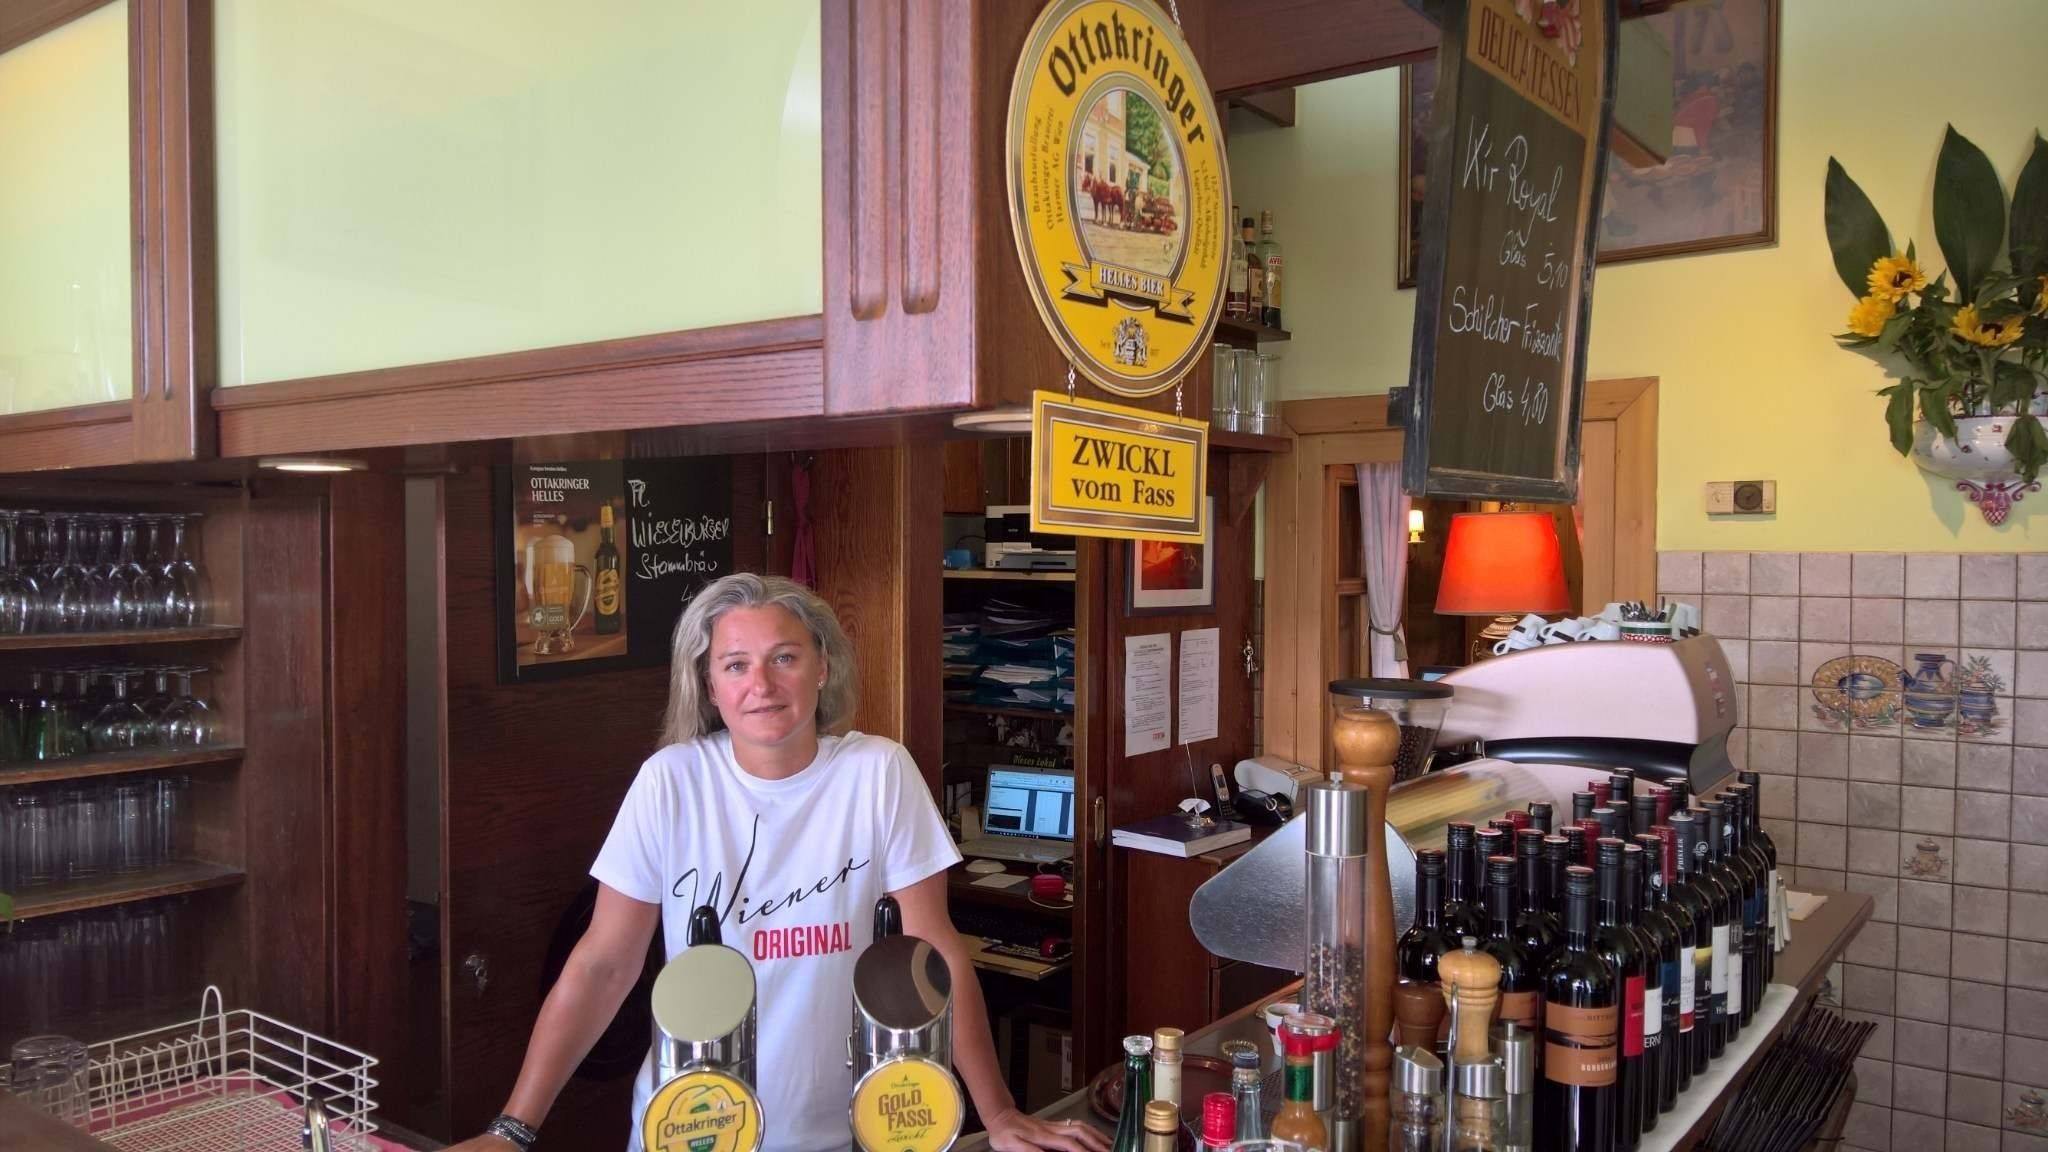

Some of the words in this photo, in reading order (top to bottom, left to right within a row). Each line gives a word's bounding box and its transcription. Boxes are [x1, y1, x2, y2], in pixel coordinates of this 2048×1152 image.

[1048, 9, 1205, 145] Ottakringer
[1478, 5, 1583, 124] DELICATESSEN
[1463, 115, 1499, 192] Kir
[1504, 134, 1563, 247] Royal
[1499, 230, 1528, 268] Glas
[1537, 252, 1569, 291] 5,10
[1099, 267, 1139, 291] HELLES
[1140, 276, 1165, 297] BIER
[1483, 372, 1514, 413] Glas
[1520, 376, 1549, 427] 4,80
[1071, 434, 1176, 478] ZWICKL
[530, 477, 590, 490] OTTAKRINGER
[531, 490, 565, 502] HELLES
[1071, 477, 1121, 502] vom
[1132, 479, 1175, 508] Fass
[672, 813, 870, 947] Wiener
[753, 921, 853, 961] ORIGINAL
[878, 1089, 922, 1116] GOLD
[887, 1108, 937, 1132] FASSL
[663, 1112, 737, 1138] Ottakringer
[690, 1137, 715, 1147] HELLES
